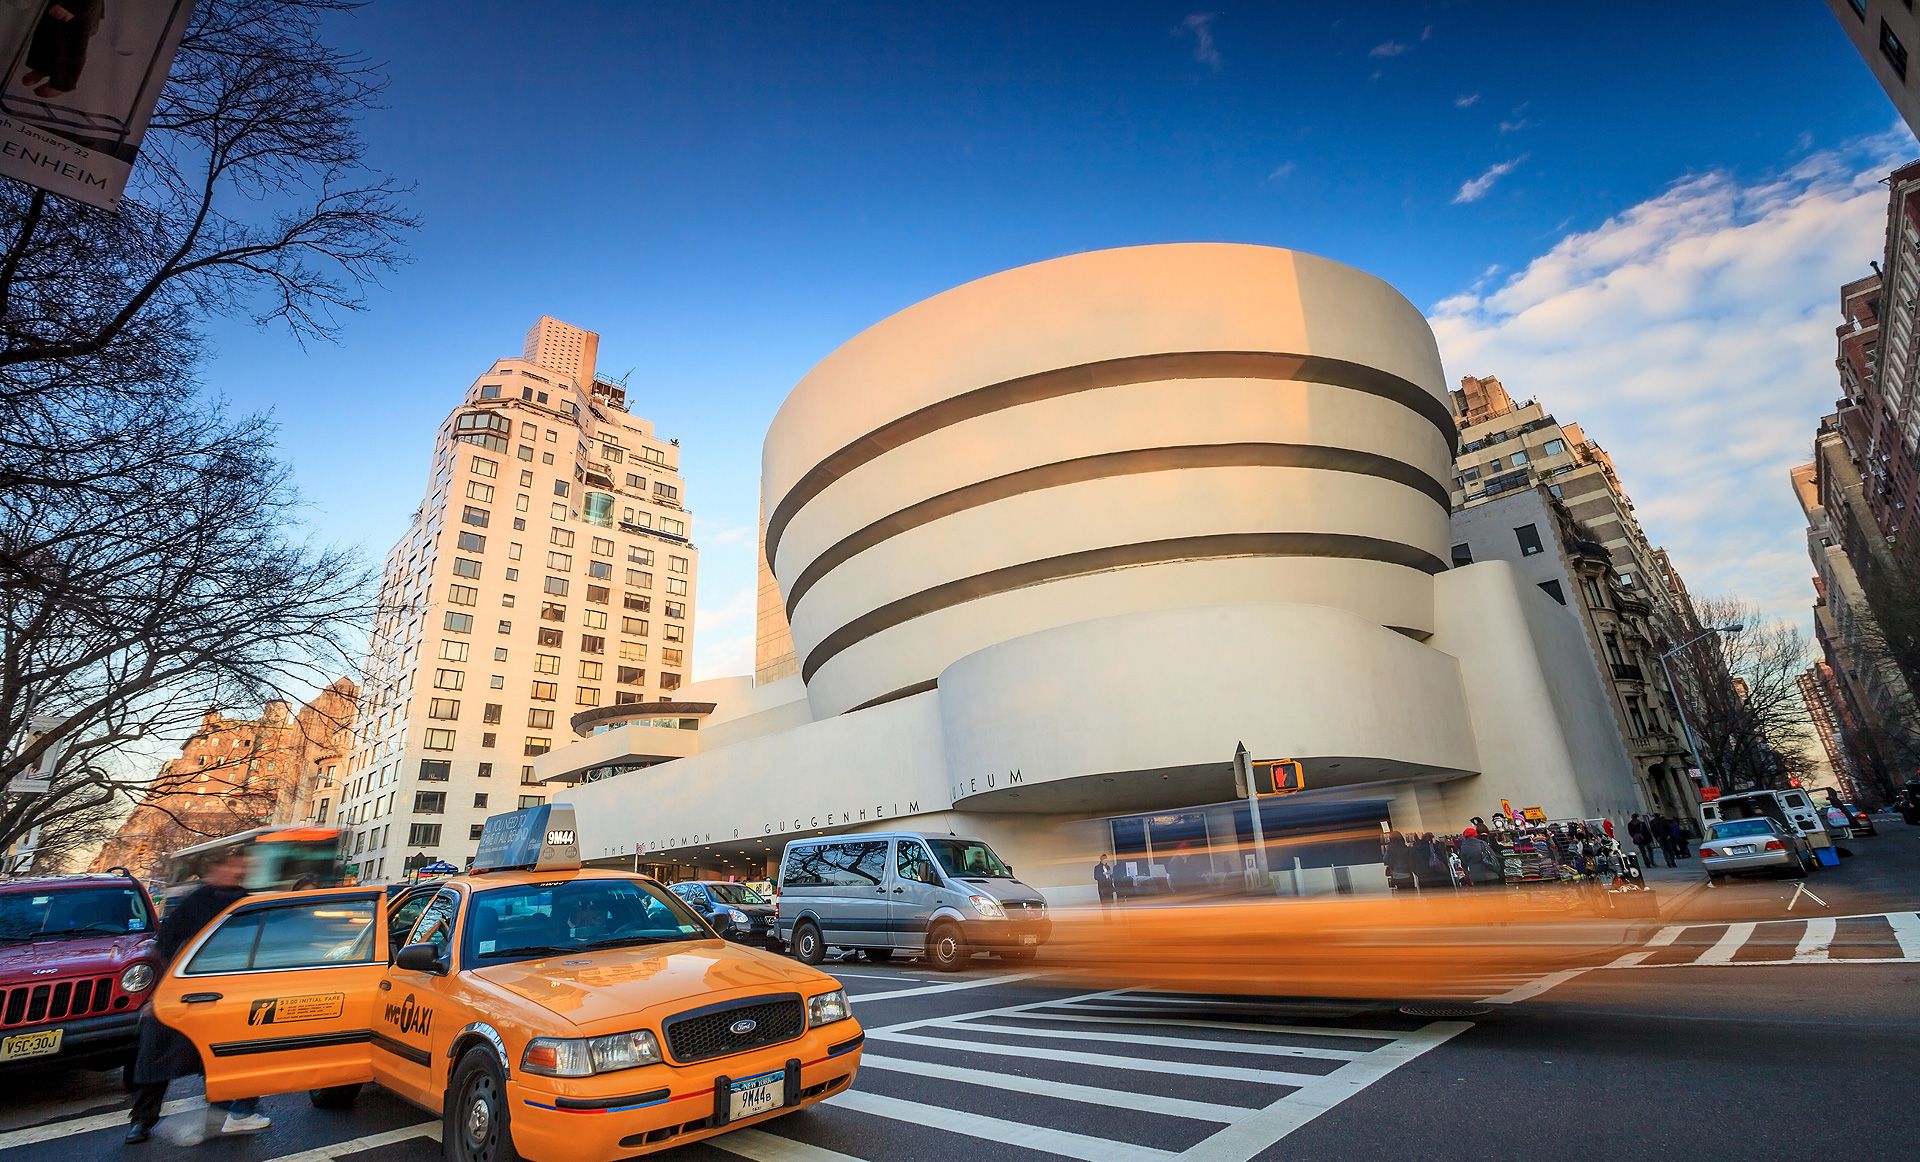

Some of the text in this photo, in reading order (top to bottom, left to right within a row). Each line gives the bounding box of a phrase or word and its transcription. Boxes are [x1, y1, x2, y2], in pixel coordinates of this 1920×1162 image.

[16, 125, 71, 151] January
[74, 148, 89, 159] 22
[547, 831, 574, 845] 9M44
[604, 845, 624, 856] THE
[733, 828, 739, 839] R
[764, 800, 920, 834] GUGGENHEIM
